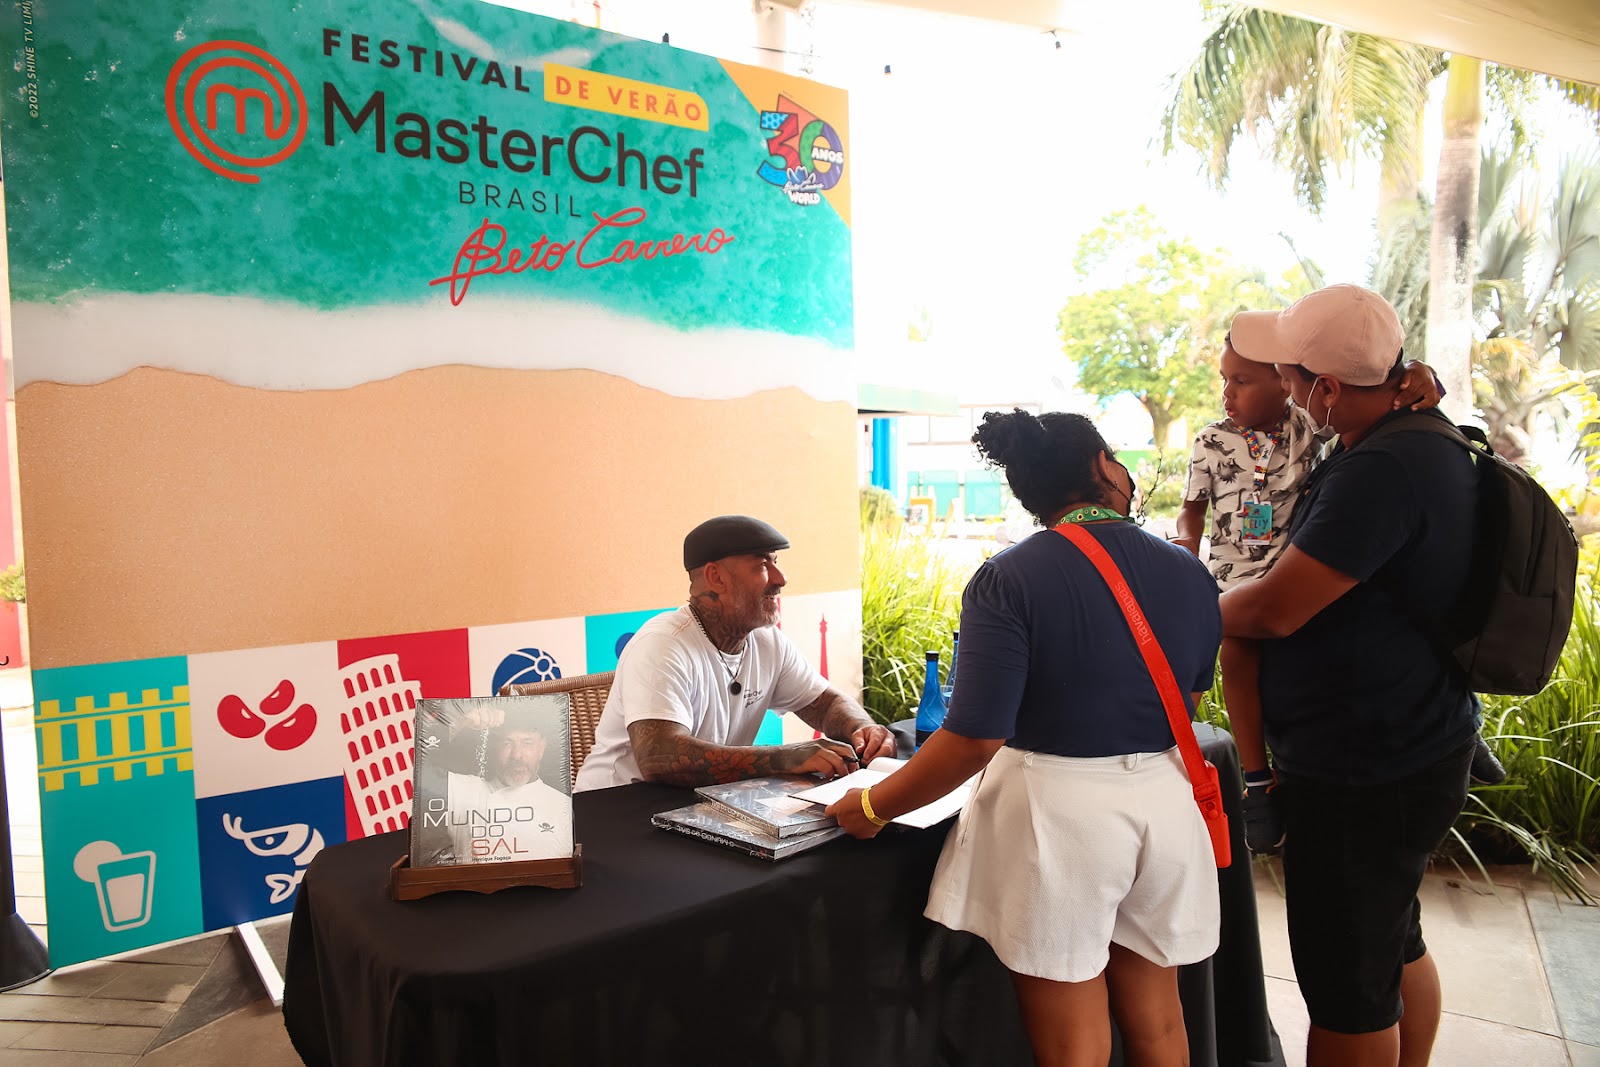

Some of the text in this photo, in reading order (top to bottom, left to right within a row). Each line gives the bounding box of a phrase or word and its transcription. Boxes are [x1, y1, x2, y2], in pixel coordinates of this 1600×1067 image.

[24, 27, 34, 42] TV
[25, 46, 37, 79] SHINE
[322, 27, 702, 122] FESTIVAL DE VERÃO
[322, 80, 704, 198] MasterChef
[811, 147, 845, 165] ANOS
[458, 187, 583, 219] BRASIL
[788, 190, 821, 206] WORLD
[428, 206, 736, 308] Beto Carrero
[1114, 580, 1153, 647] havaianas
[428, 798, 445, 812] O
[423, 806, 534, 828] MUNDO
[471, 824, 504, 839] DO
[471, 837, 529, 856] SAL
